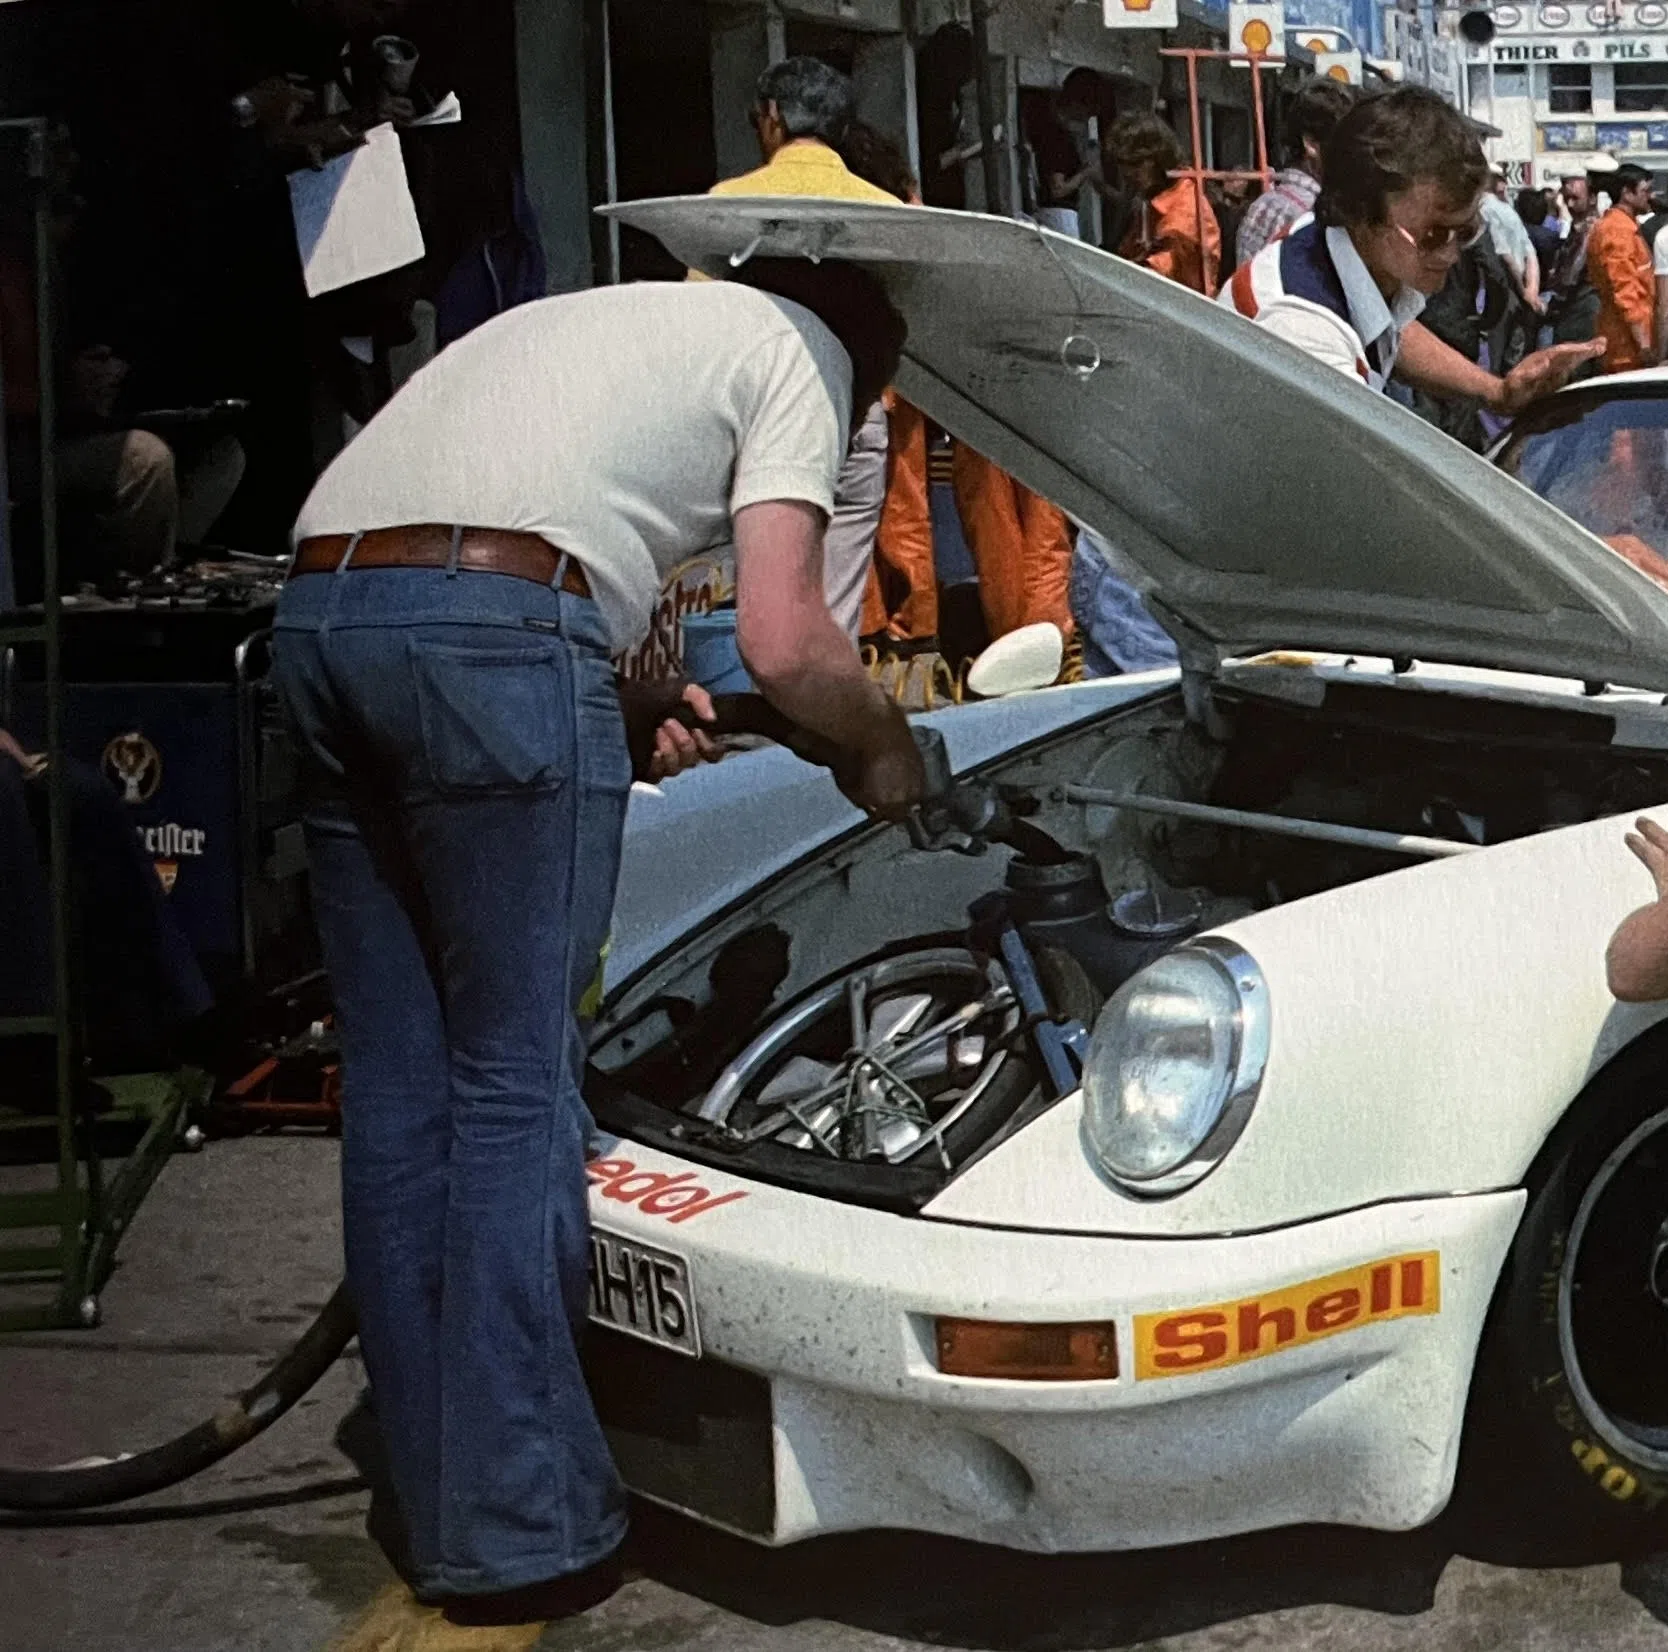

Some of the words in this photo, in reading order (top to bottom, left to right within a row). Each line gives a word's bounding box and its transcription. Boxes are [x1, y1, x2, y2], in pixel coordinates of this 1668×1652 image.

[1494, 45, 1558, 60] THIER
[1605, 43, 1650, 58] PILS
[1153, 1259, 1425, 1369] Shell
